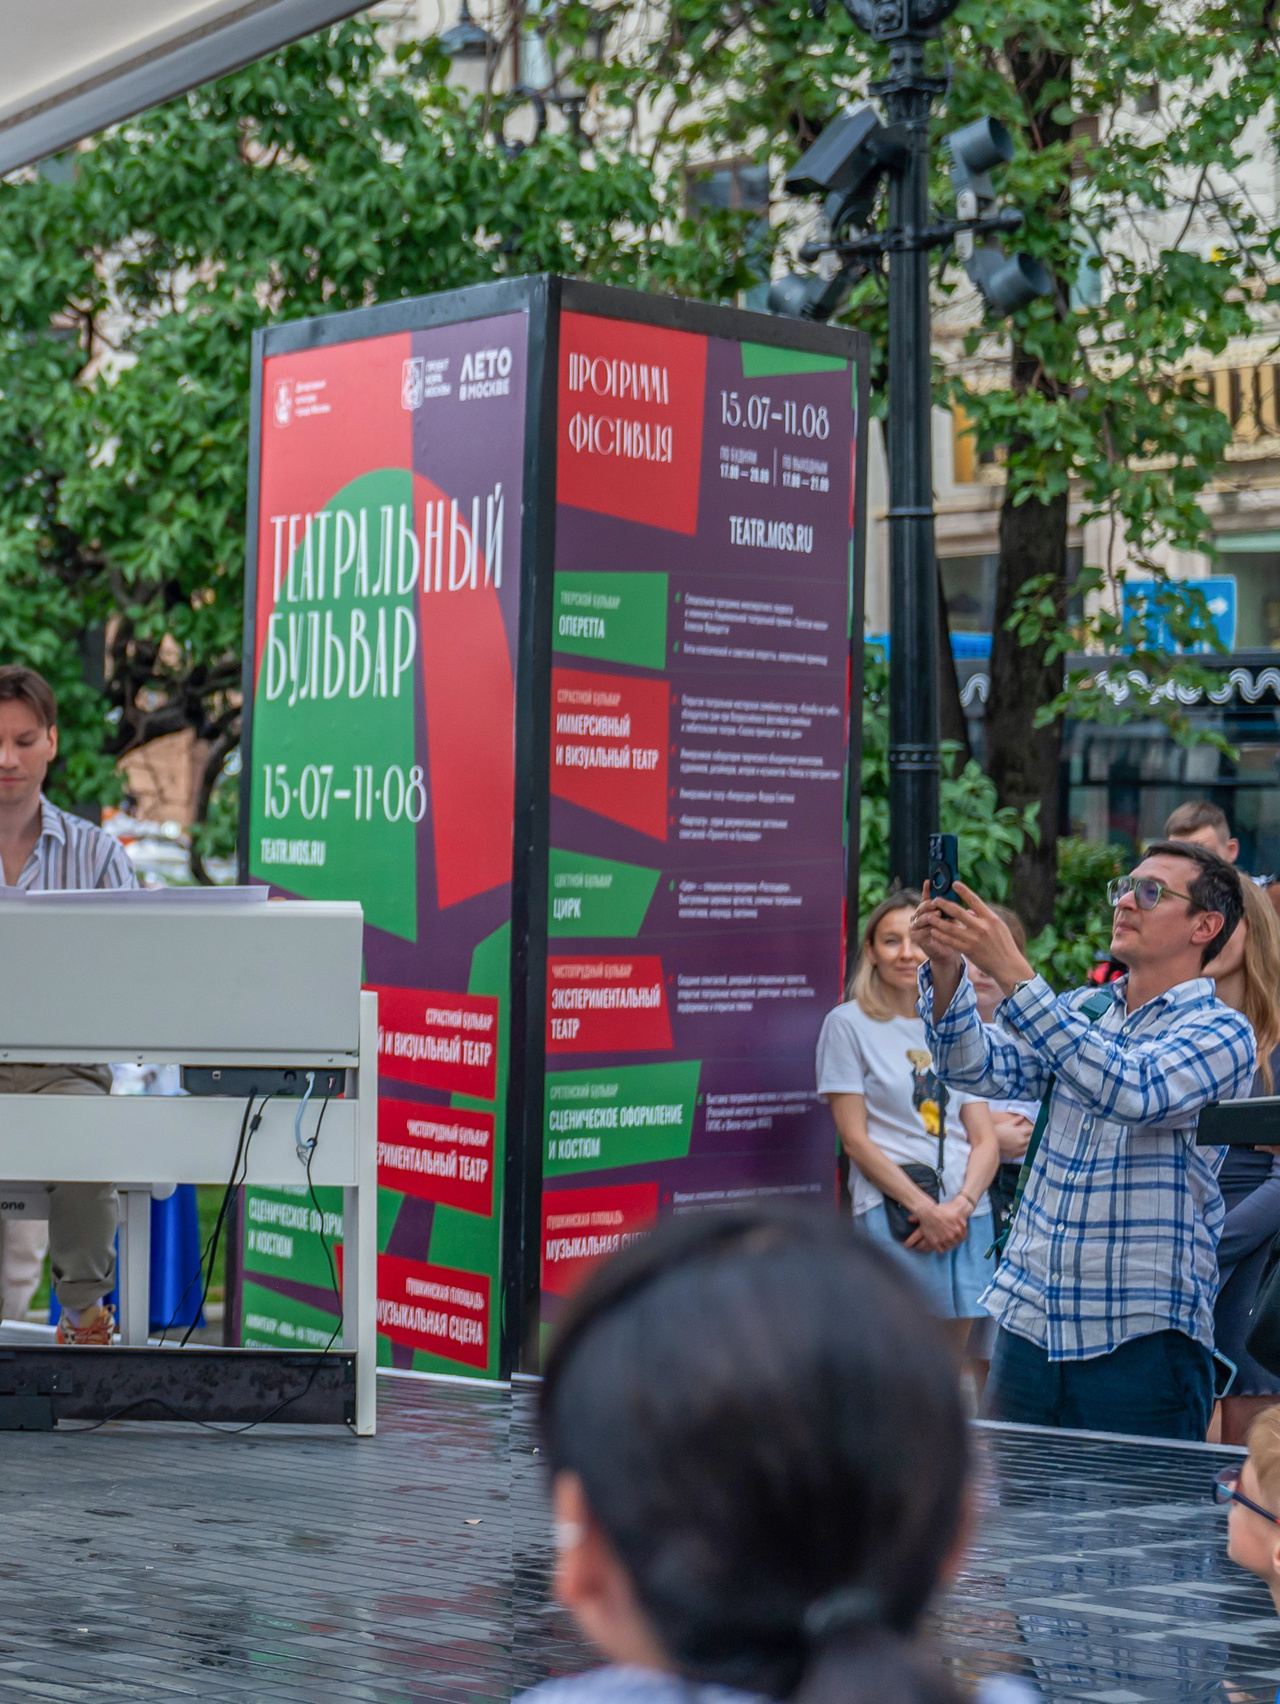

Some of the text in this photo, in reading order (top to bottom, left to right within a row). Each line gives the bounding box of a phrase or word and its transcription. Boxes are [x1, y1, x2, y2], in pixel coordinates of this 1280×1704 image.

[460, 346, 512, 382] ЛЕТО
[467, 377, 510, 399] МОСКВЕ
[270, 482, 504, 603] ТЕАТРАЛЬНЫЙ
[729, 515, 813, 553] TEATR.MOS.RU
[559, 614, 605, 639] ОПЕРЕТТА
[266, 605, 417, 707] БУЛЬВАР
[556, 712, 631, 738] ИММЕРСИВНЫЙ
[556, 744, 563, 766] И
[565, 743, 630, 769] ВИЗУАЛЬНЫЙ
[632, 748, 659, 771] ТЕАТР
[260, 838, 326, 866] TEATR.MOS.RU
[553, 897, 581, 921] ЦИРК
[552, 983, 661, 1010] ЭКСПЕРИМЕНТАЛЬНЫЙ
[551, 1017, 580, 1040] ТЕАТР
[385, 1031, 393, 1055] И
[394, 1032, 460, 1063] ВИЗУАЛЬНЫЙ
[462, 1040, 492, 1067] ТЕАТР
[549, 1107, 618, 1132] СЦЕНИЧЕСКОЕ
[620, 1104, 683, 1128] ОФОРМЛЕНИЕ
[548, 1136, 601, 1160] И КОСТЮМ
[458, 1155, 489, 1183] ТЕАТР
[249, 1197, 343, 1239] СЦЕНИЧЕСКОЕ ОФОРМ
[248, 1229, 255, 1251] И
[546, 1234, 619, 1262] МУЗЫКАЛЬНАЯ
[449, 1315, 484, 1346] СЦЕНА
